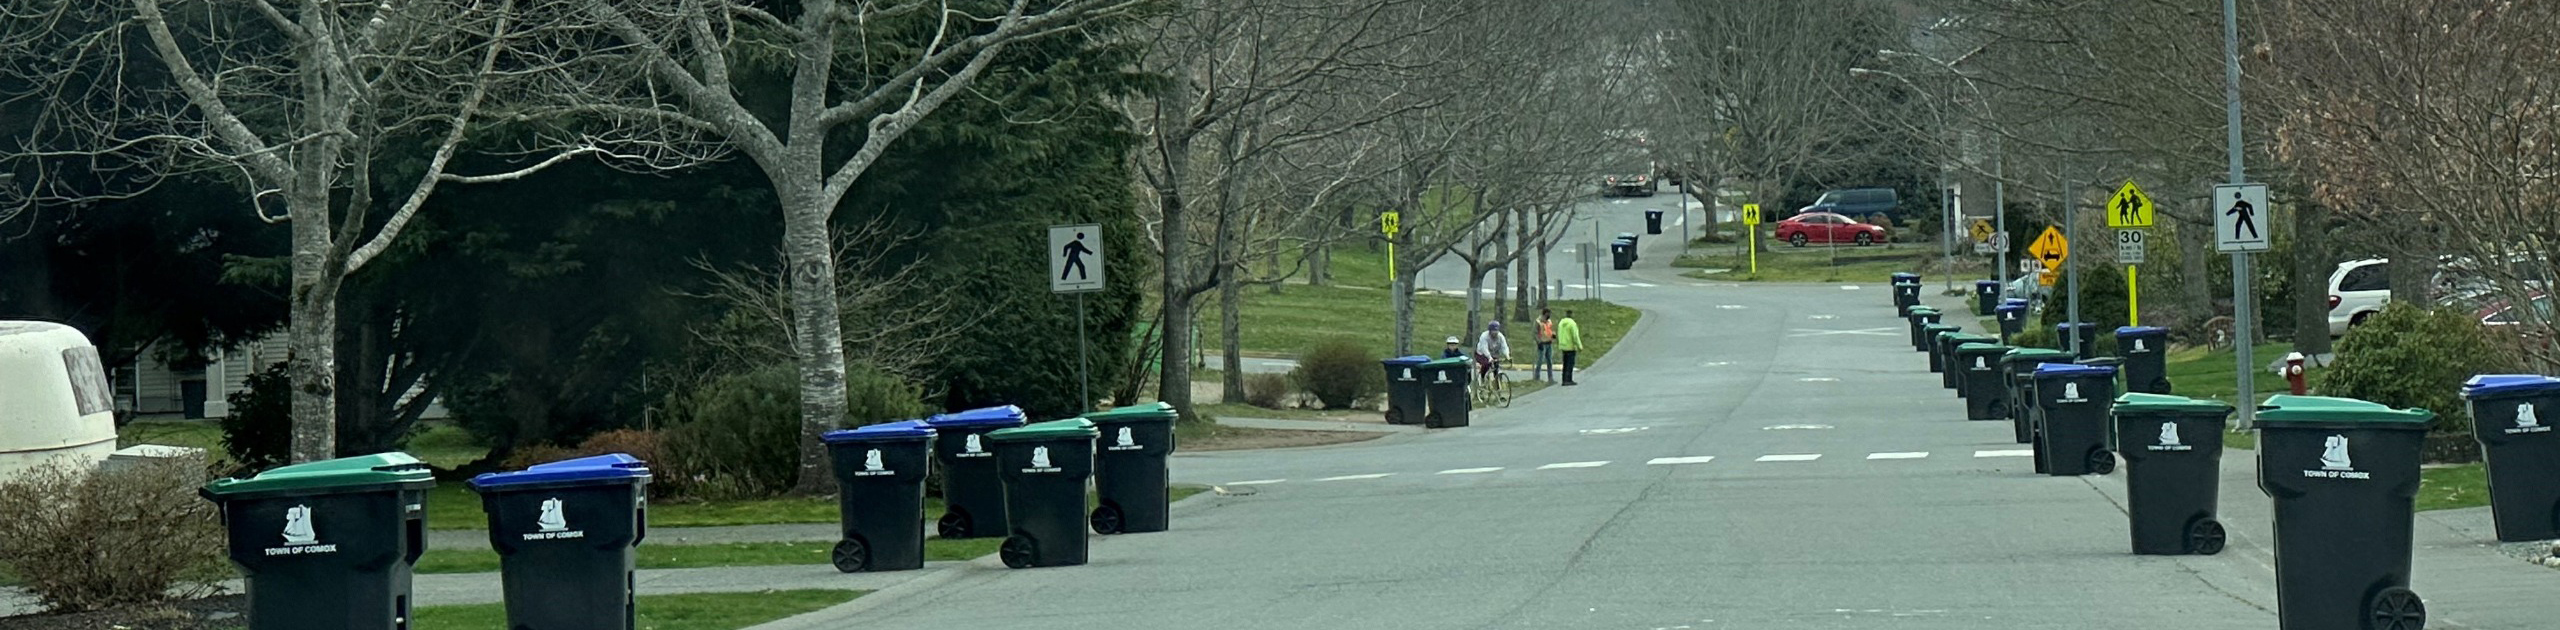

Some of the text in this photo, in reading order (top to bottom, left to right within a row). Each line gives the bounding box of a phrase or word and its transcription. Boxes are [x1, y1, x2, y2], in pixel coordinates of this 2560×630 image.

[2120, 231, 2141, 243] 30
[2340, 471, 2370, 479] COMOX
[523, 533, 544, 541] TOWN
[265, 544, 337, 556] TOWN OF COMOX
